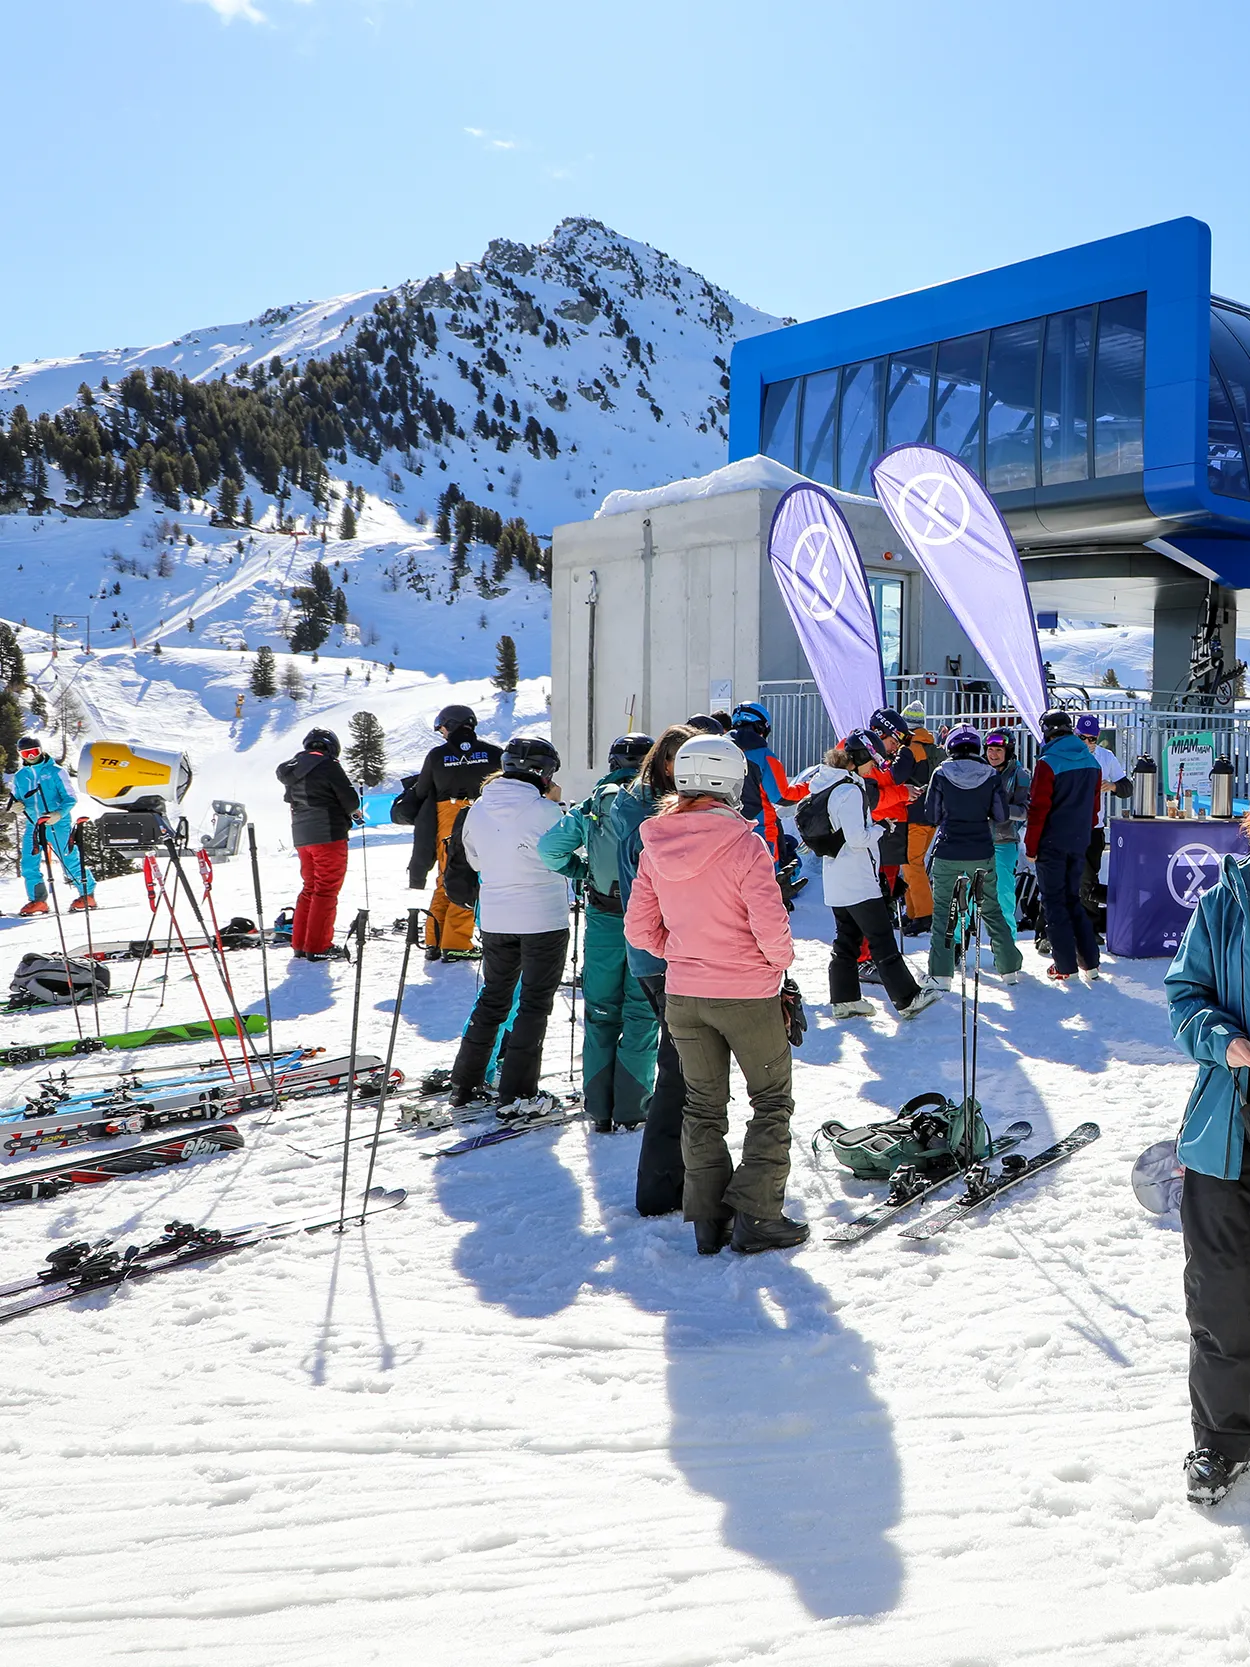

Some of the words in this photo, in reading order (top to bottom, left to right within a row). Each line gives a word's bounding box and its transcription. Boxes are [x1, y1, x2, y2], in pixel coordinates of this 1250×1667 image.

[1171, 738, 1198, 755] MIAM
[307, 1087, 335, 1096] ATOMIC
[181, 1138, 221, 1159] elan
